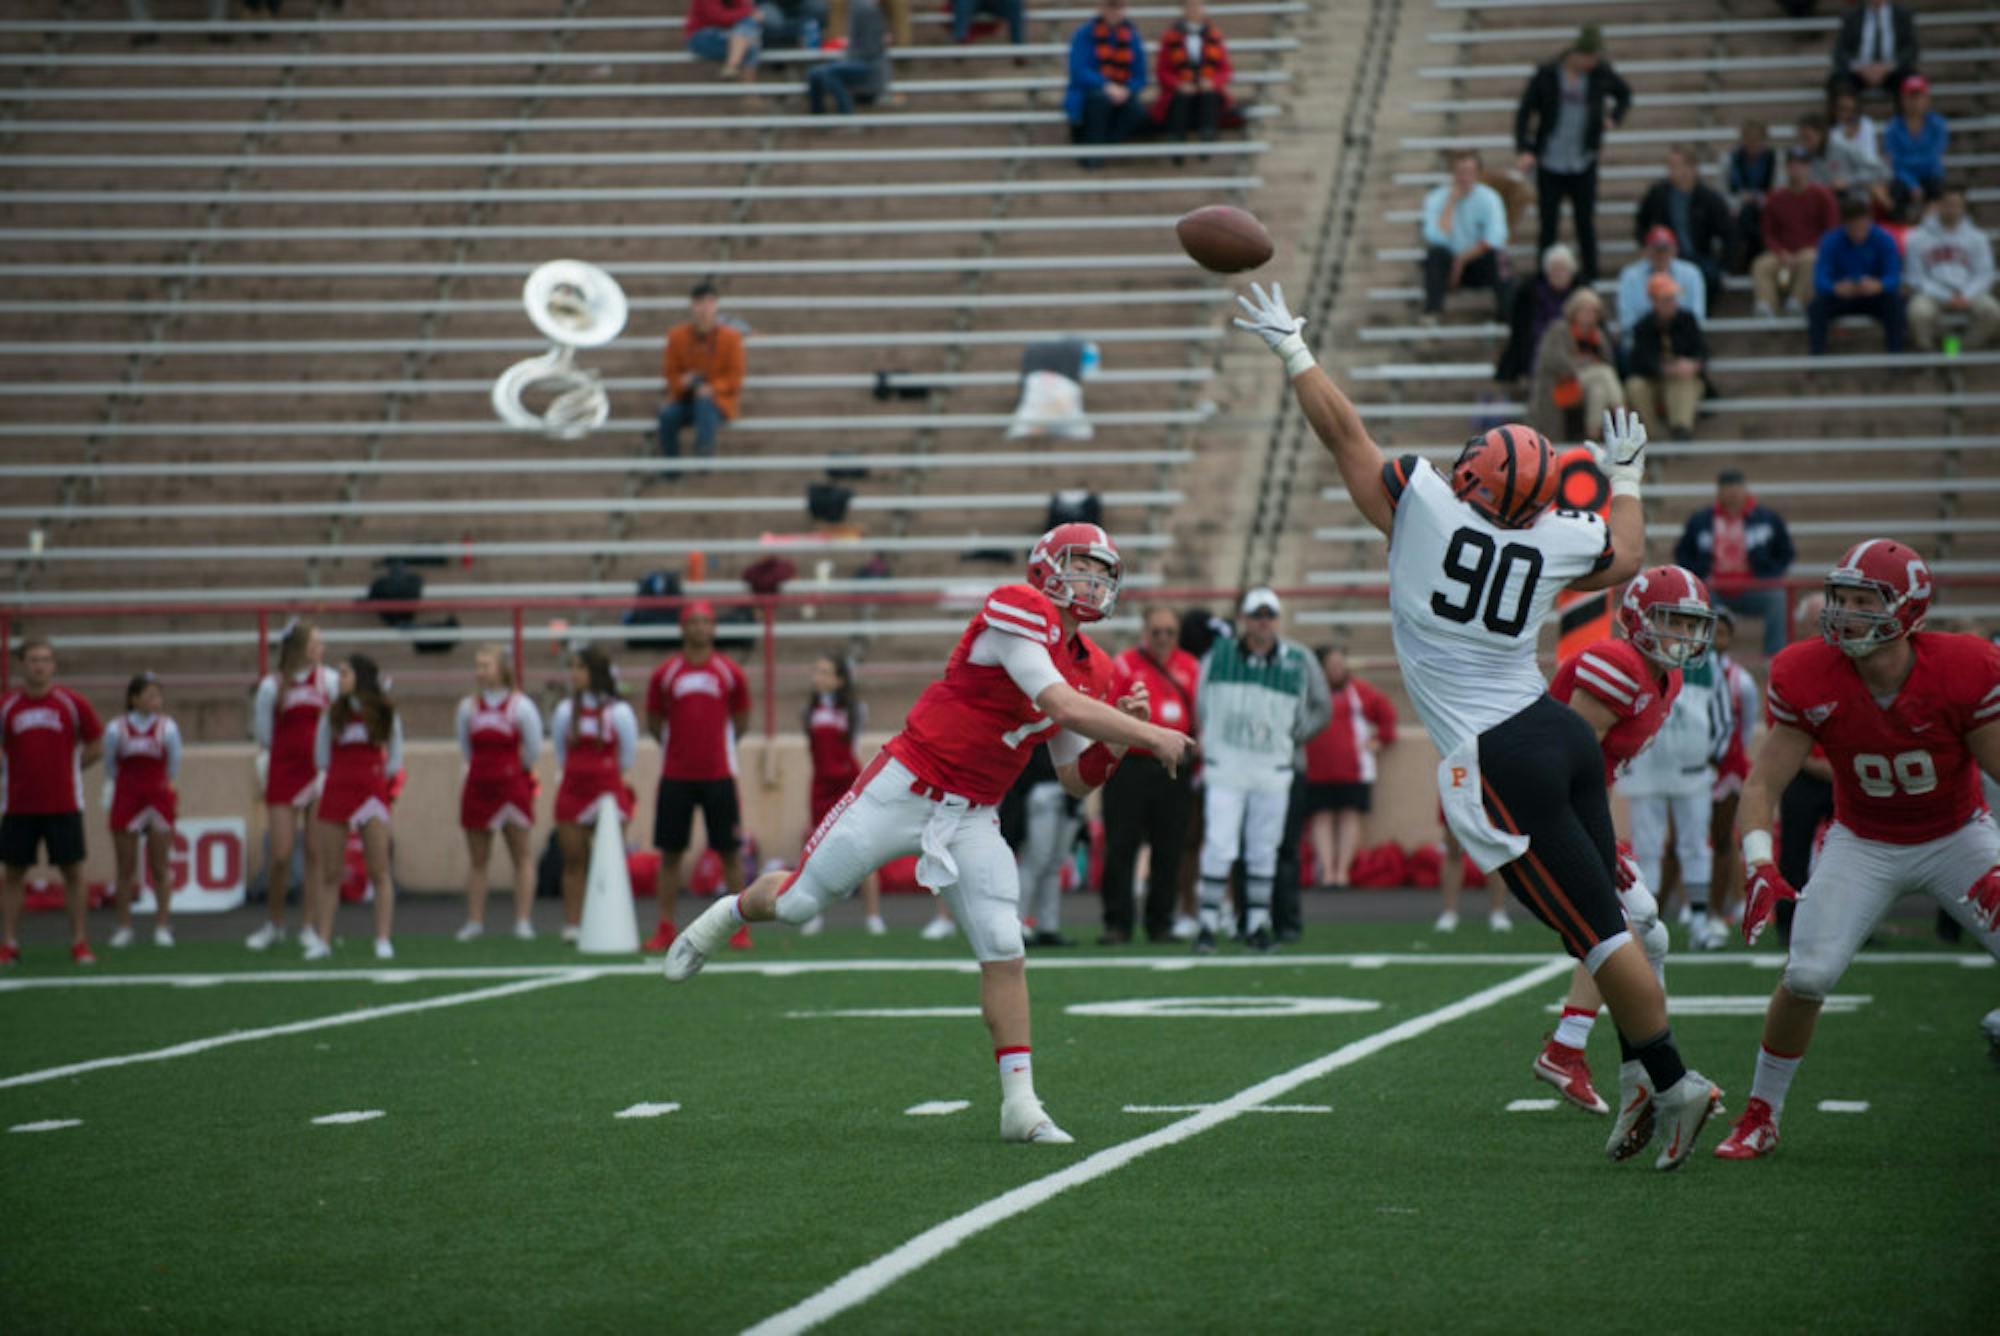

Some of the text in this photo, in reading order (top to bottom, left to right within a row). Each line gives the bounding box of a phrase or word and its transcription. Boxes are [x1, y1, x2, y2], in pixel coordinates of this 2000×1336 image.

[1430, 525, 1544, 638] 90
[1623, 574, 1650, 610] C
[1906, 559, 1933, 600] C
[1450, 766, 1468, 788] P
[804, 790, 857, 855] CORNELL
